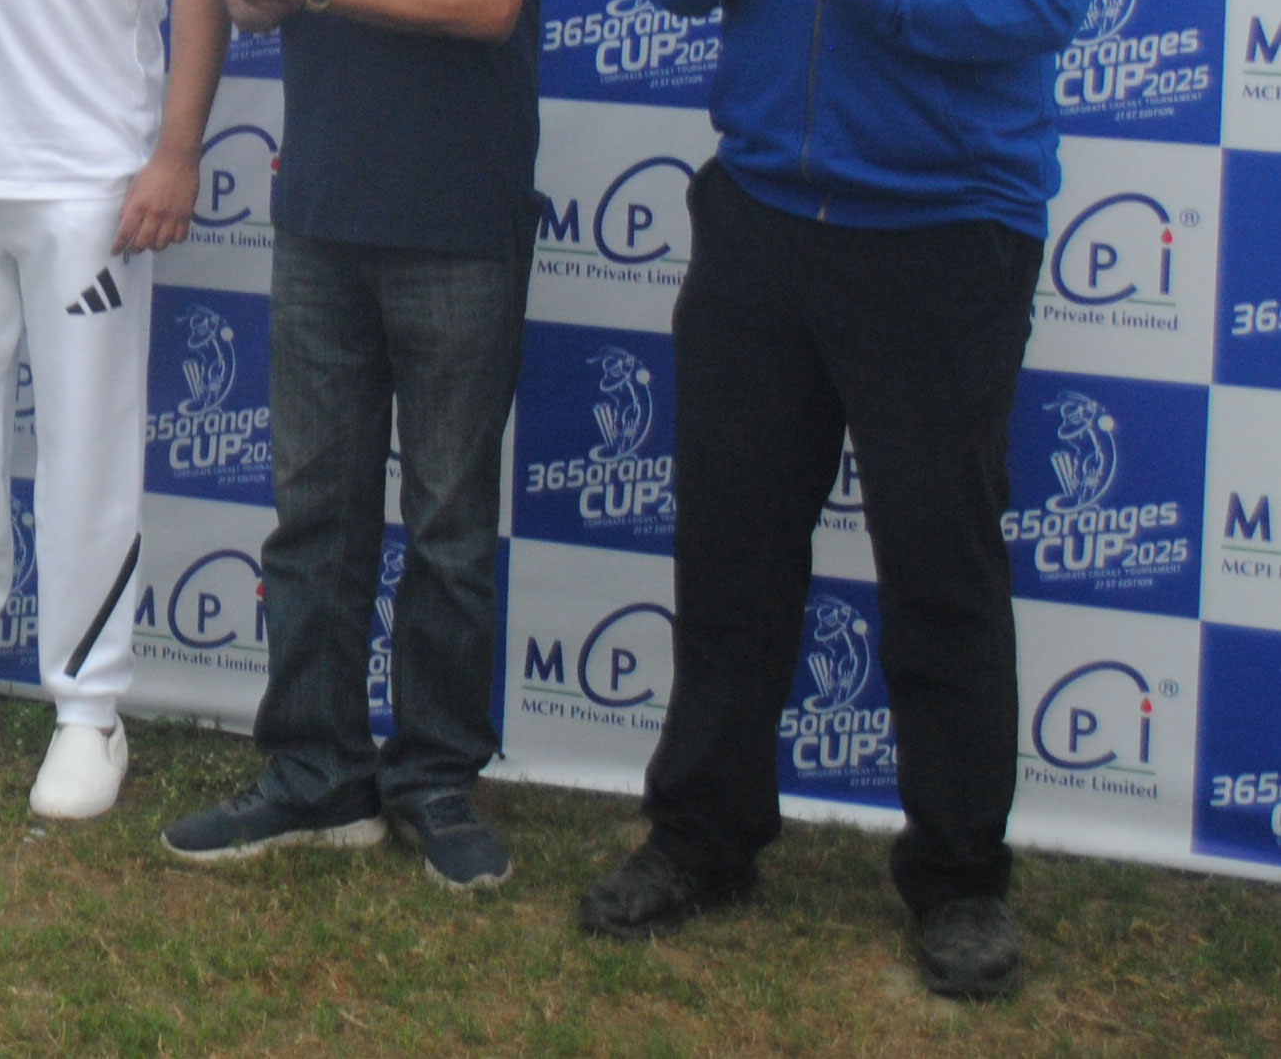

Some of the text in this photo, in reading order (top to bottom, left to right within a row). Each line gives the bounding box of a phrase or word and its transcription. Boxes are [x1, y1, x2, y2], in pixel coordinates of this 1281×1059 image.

[1056, 29, 1198, 71] oranges
[586, 262, 641, 281] Private
[1045, 303, 1178, 331] Private Limited
[1001, 501, 1177, 544] 65oranges
[161, 645, 210, 666] Private
[522, 697, 624, 725] MCPI Private
[1025, 765, 1157, 799] Private Limited
